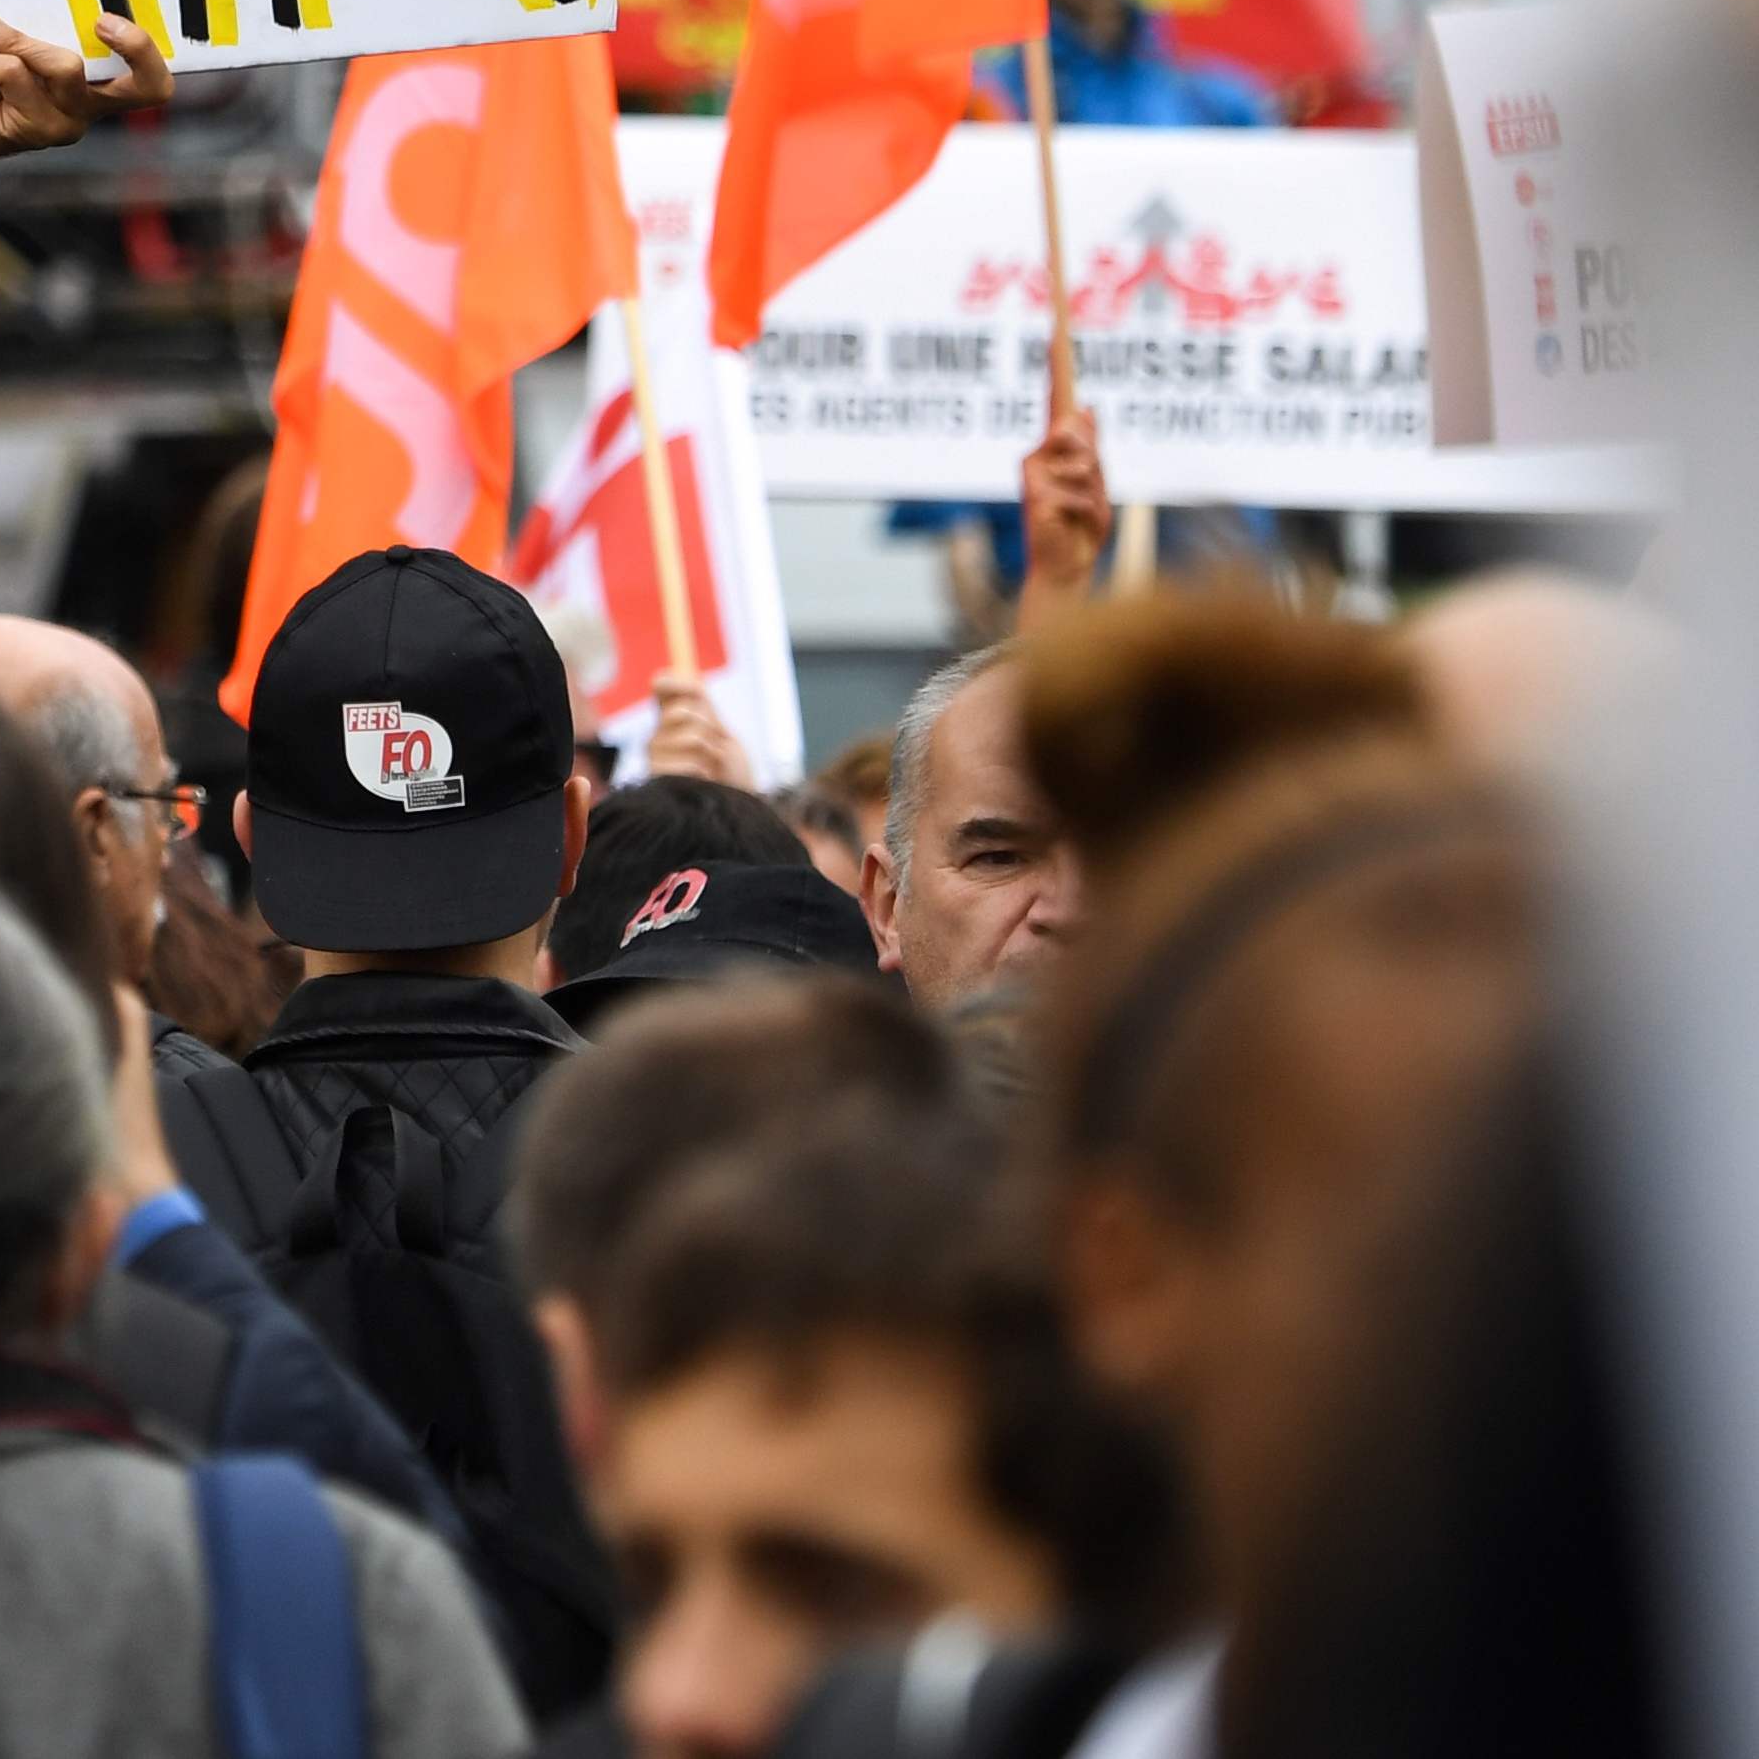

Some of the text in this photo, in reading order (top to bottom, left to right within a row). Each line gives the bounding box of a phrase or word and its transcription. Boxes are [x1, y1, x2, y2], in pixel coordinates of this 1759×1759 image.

[753, 326, 862, 374] OUR
[887, 330, 991, 378] UNE
[813, 392, 967, 429] AGENTS
[985, 396, 1035, 432] DE
[347, 705, 400, 732] FEETS
[381, 729, 433, 784] FO
